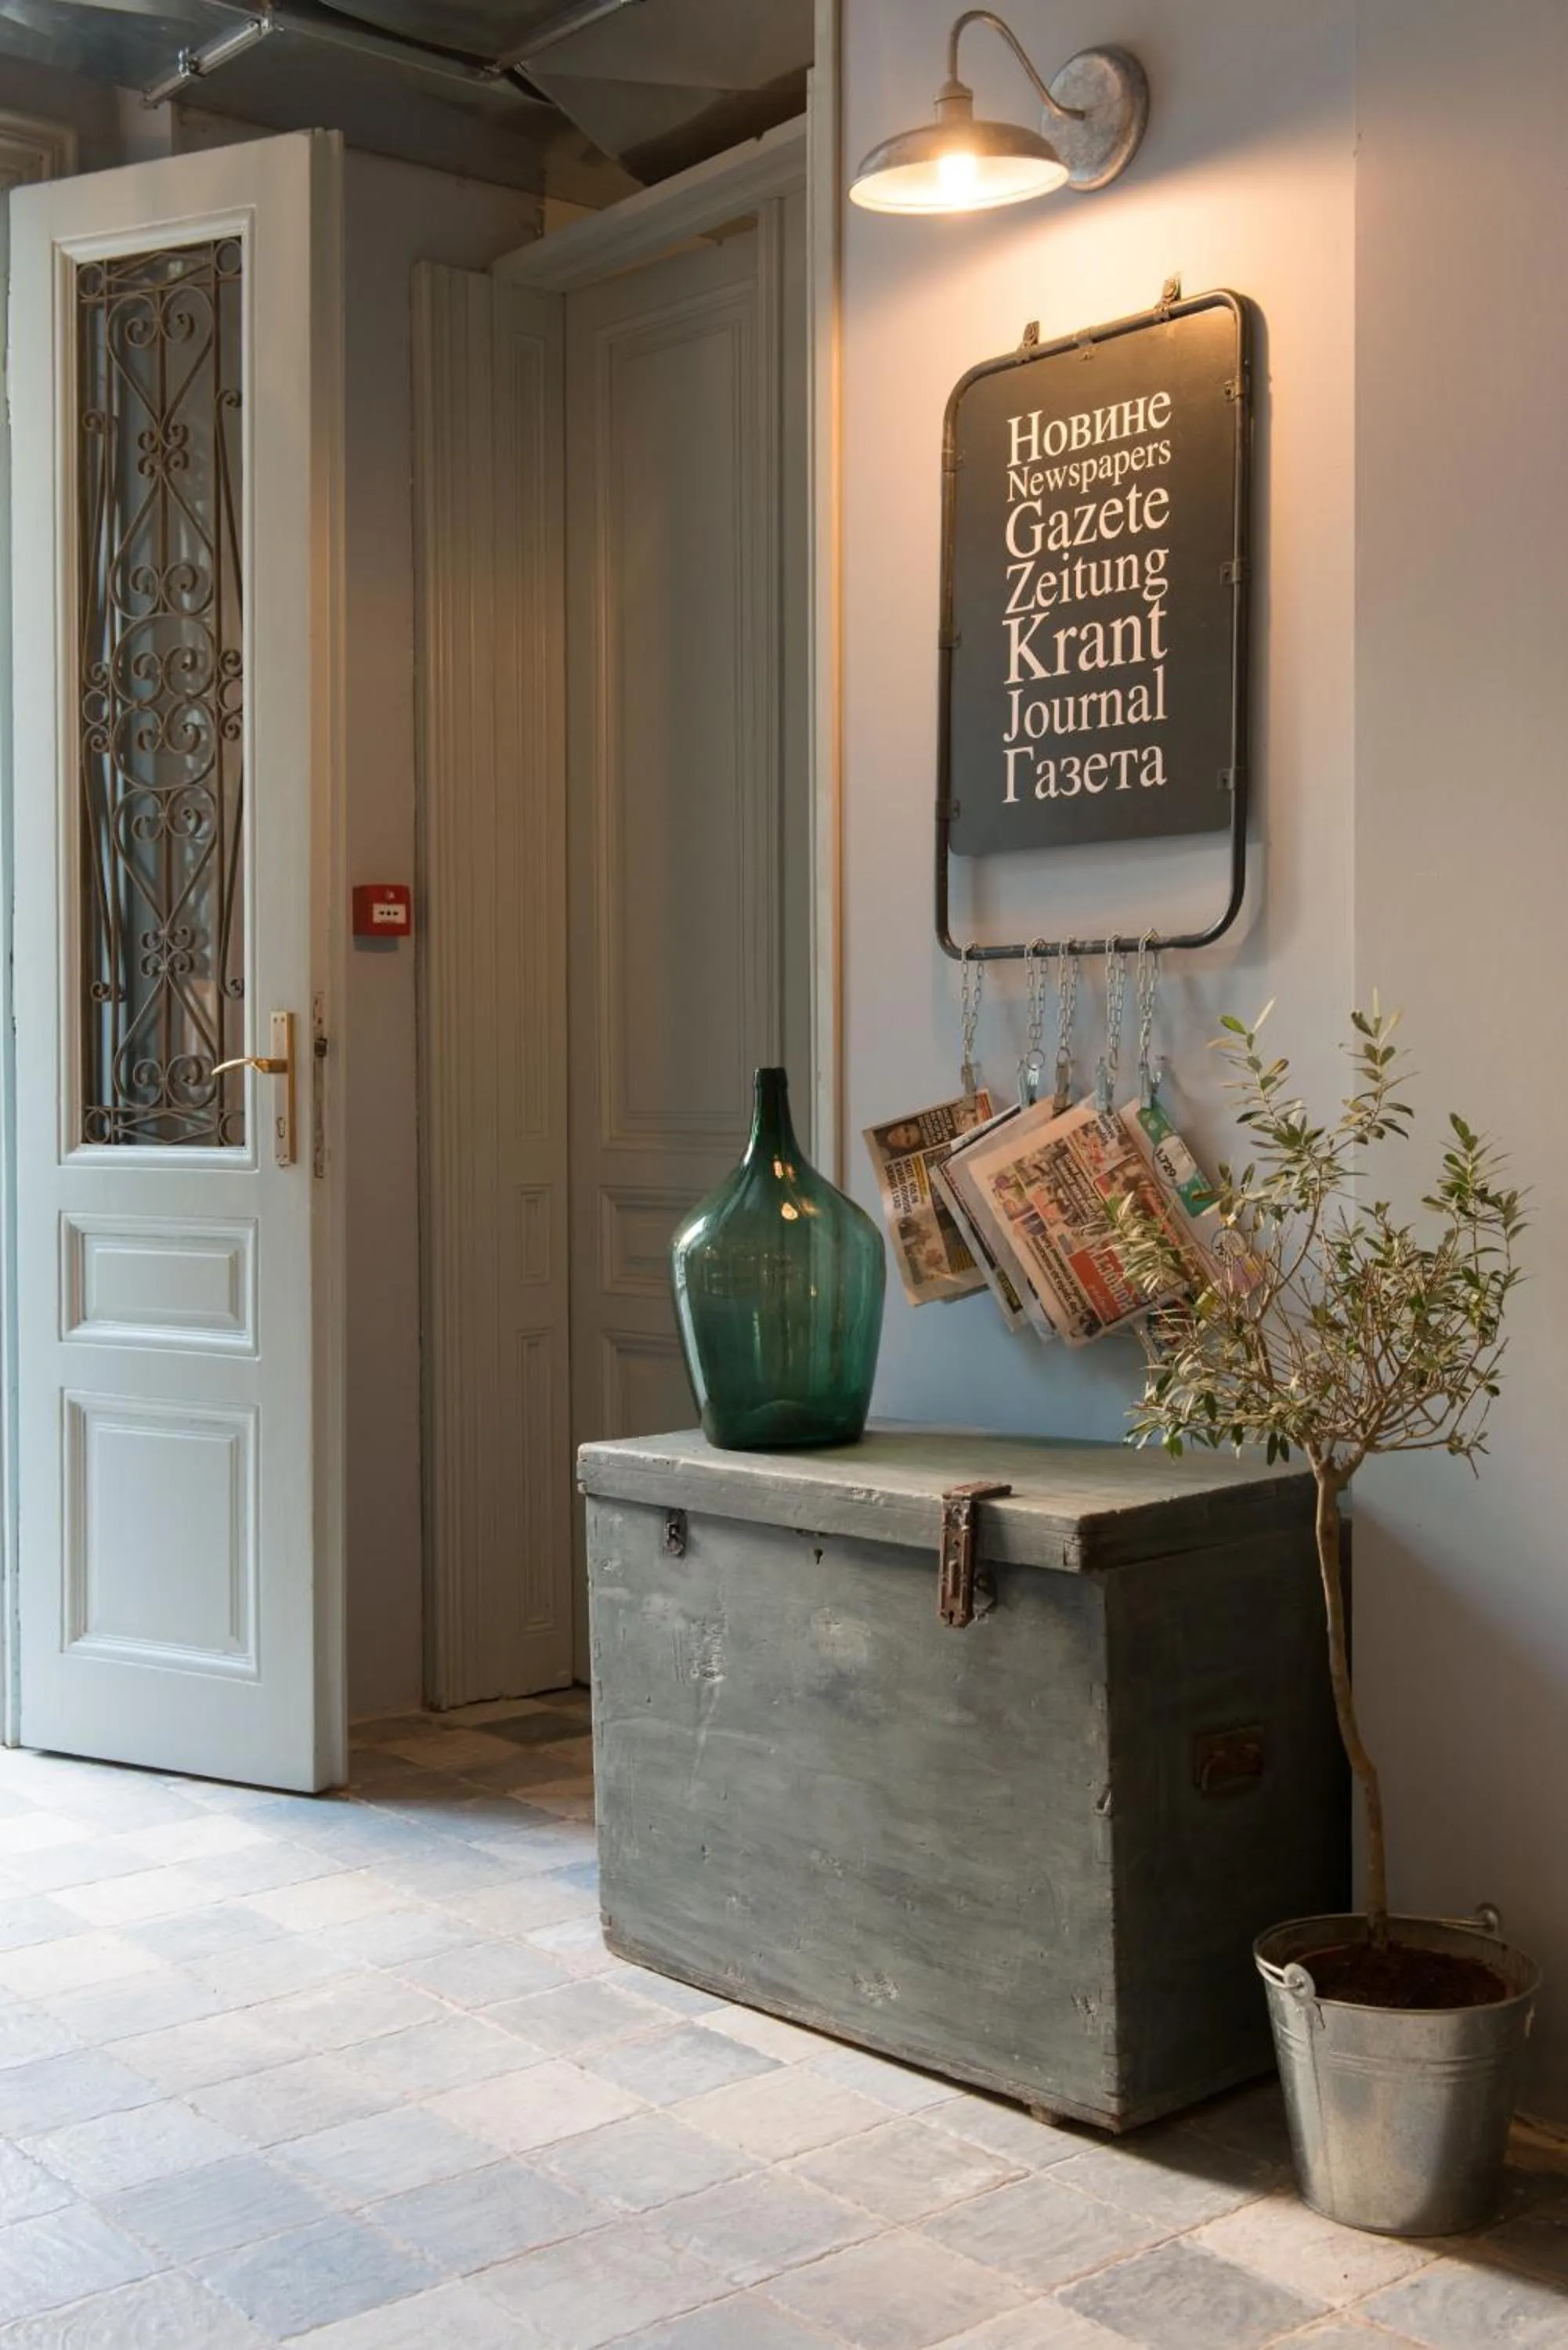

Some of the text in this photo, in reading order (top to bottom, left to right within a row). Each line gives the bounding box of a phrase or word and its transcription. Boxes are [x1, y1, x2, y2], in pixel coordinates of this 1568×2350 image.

[1006, 391, 1172, 468] Новине
[1006, 439, 1171, 502] Newspapers
[1005, 483, 1170, 559] Gazete
[1005, 548, 1169, 615] Zeitung
[1002, 599, 1168, 685] Krant
[1003, 664, 1167, 743] Journal
[1003, 746, 1167, 803] Газета
